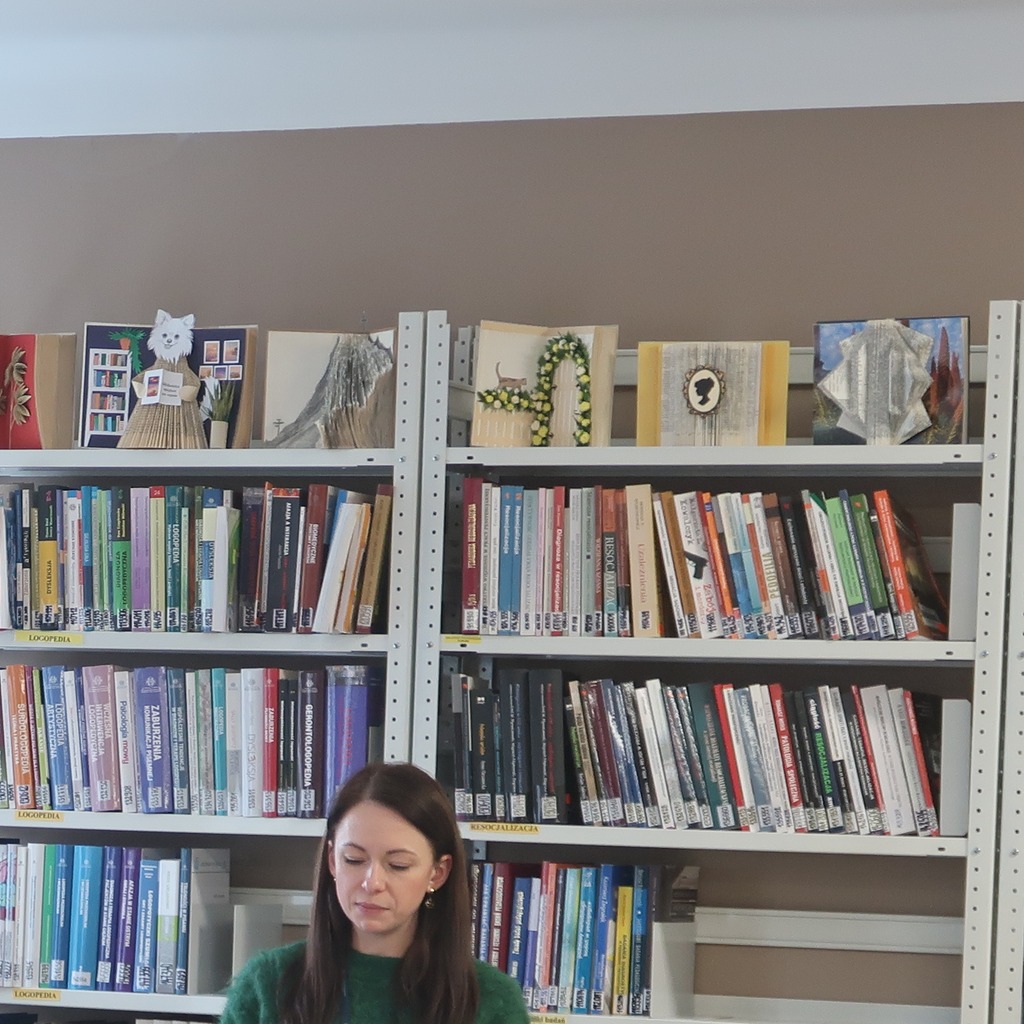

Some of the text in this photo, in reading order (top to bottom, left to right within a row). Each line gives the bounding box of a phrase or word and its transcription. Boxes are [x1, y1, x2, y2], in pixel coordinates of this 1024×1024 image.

[172, 524, 180, 564] LOGOPEDIA
[310, 523, 319, 564] BIOMEDYCZNE
[555, 528, 563, 562] Diagnoza
[679, 499, 693, 546] Kowalczyk
[763, 551, 779, 600] PEDOFILIA
[28, 634, 71, 643] LOGOPEDIA
[17, 703, 30, 774] SURDOLOGOPEDIA
[46, 704, 57, 759] ARTYSTYCZNA
[55, 703, 64, 746] LOGOPEDIA
[88, 704, 97, 763] LOGOPEDYCZNA
[95, 704, 104, 756] INTERWENCJA
[103, 703, 112, 739] WCZESNA
[119, 700, 130, 764] Patologia mowy
[143, 705, 154, 781] KOMUNIKACJI PISEMNEJ
[150, 705, 162, 761] ZABURZENIA
[304, 704, 314, 787] GERONTOLOGOPEDIA
[781, 735, 799, 803] PATOLOGIA SPOŁECZNA
[815, 732, 833, 794] RESOCJALIZACJA
[470, 823, 539, 833] RESOCJALIZACJA
[146, 890, 154, 937] LOGOPOTYCZKI
[14, 991, 57, 999] LOGOPEDIA
